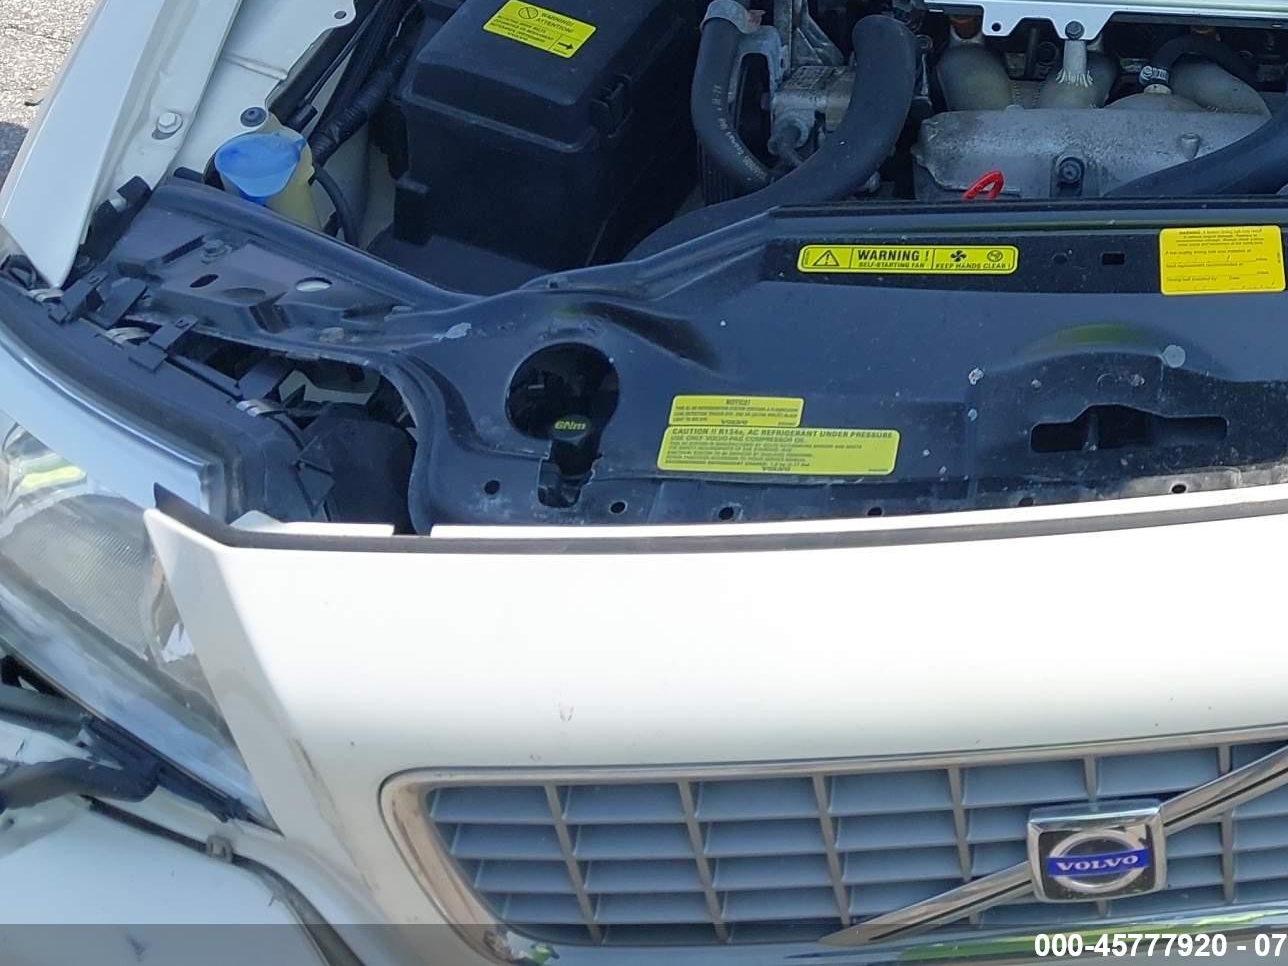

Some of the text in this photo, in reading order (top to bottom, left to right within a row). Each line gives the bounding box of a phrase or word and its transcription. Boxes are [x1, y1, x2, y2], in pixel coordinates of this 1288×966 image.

[857, 249, 920, 261] WARNING
[760, 429, 817, 437] REFRIGERANT
[1055, 855, 1139, 871] VOLVO
